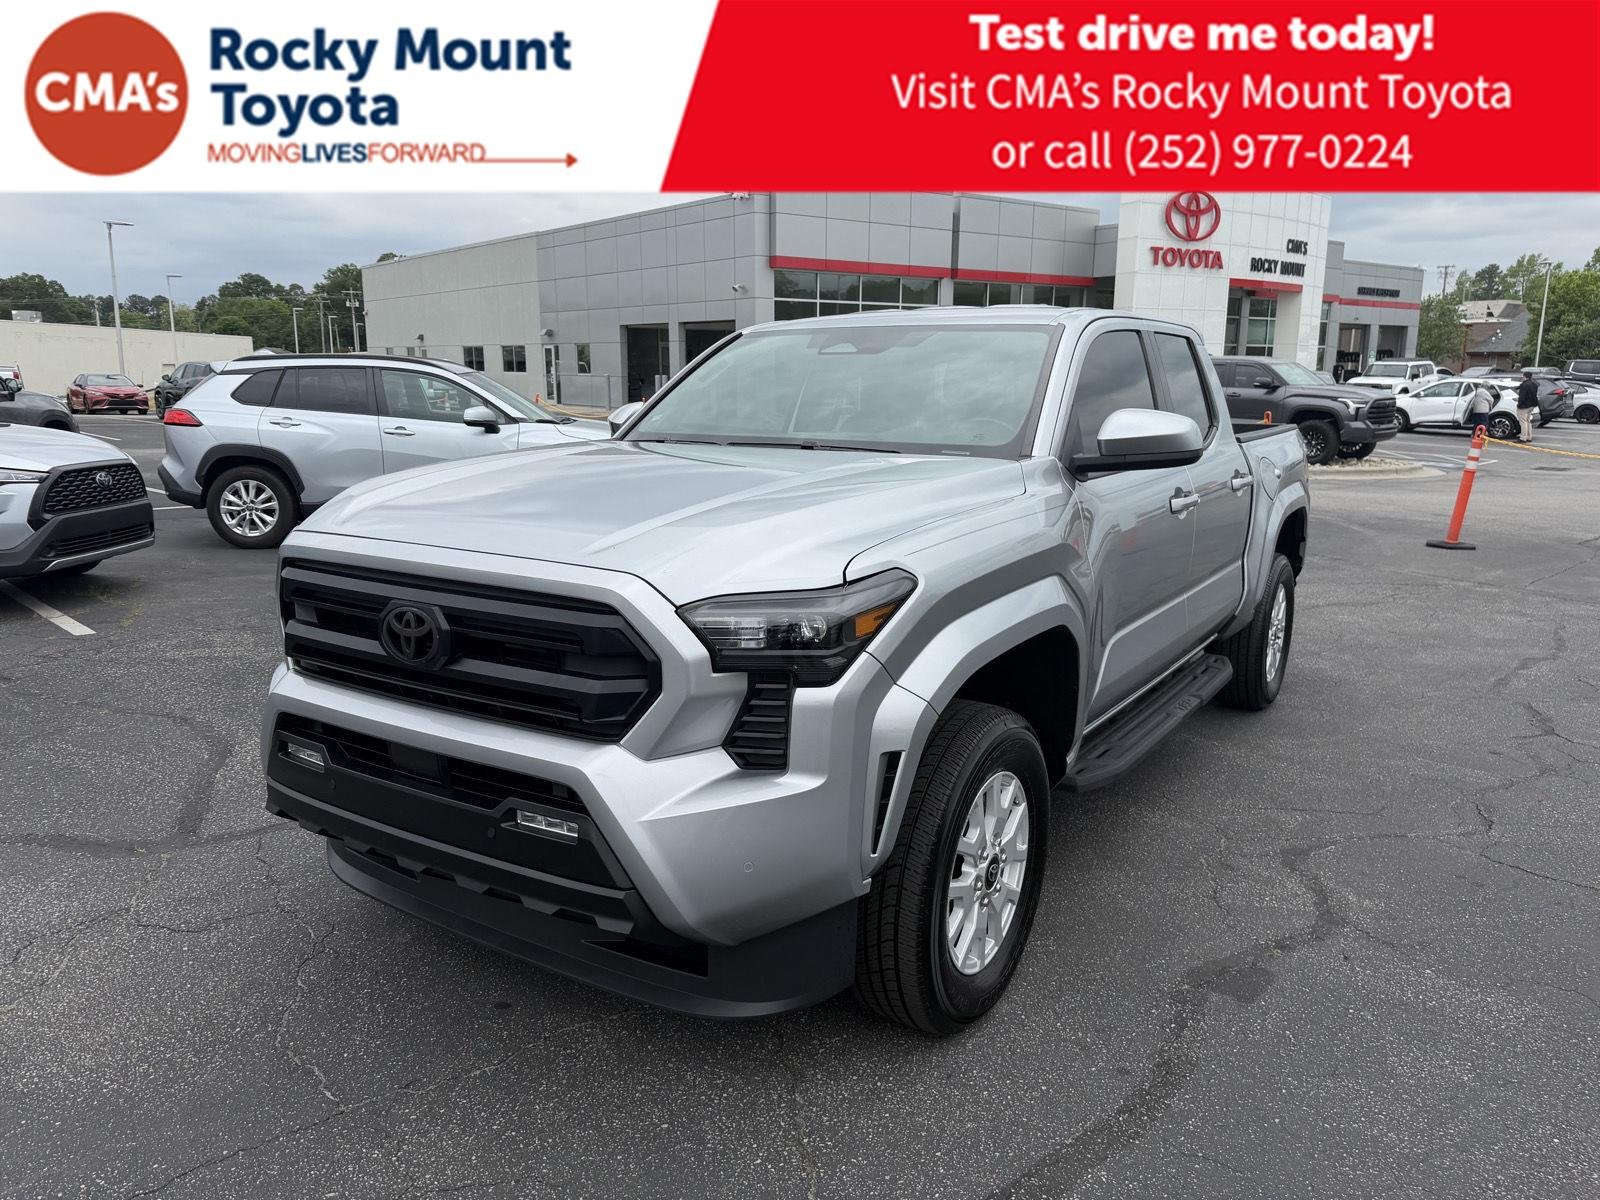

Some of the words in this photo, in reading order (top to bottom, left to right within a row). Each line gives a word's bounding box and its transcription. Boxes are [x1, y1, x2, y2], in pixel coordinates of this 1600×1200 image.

[1150, 246, 1223, 270] TOYOTA
[1250, 257, 1279, 274] ROCKY
[1280, 260, 1306, 277] MOUNT
